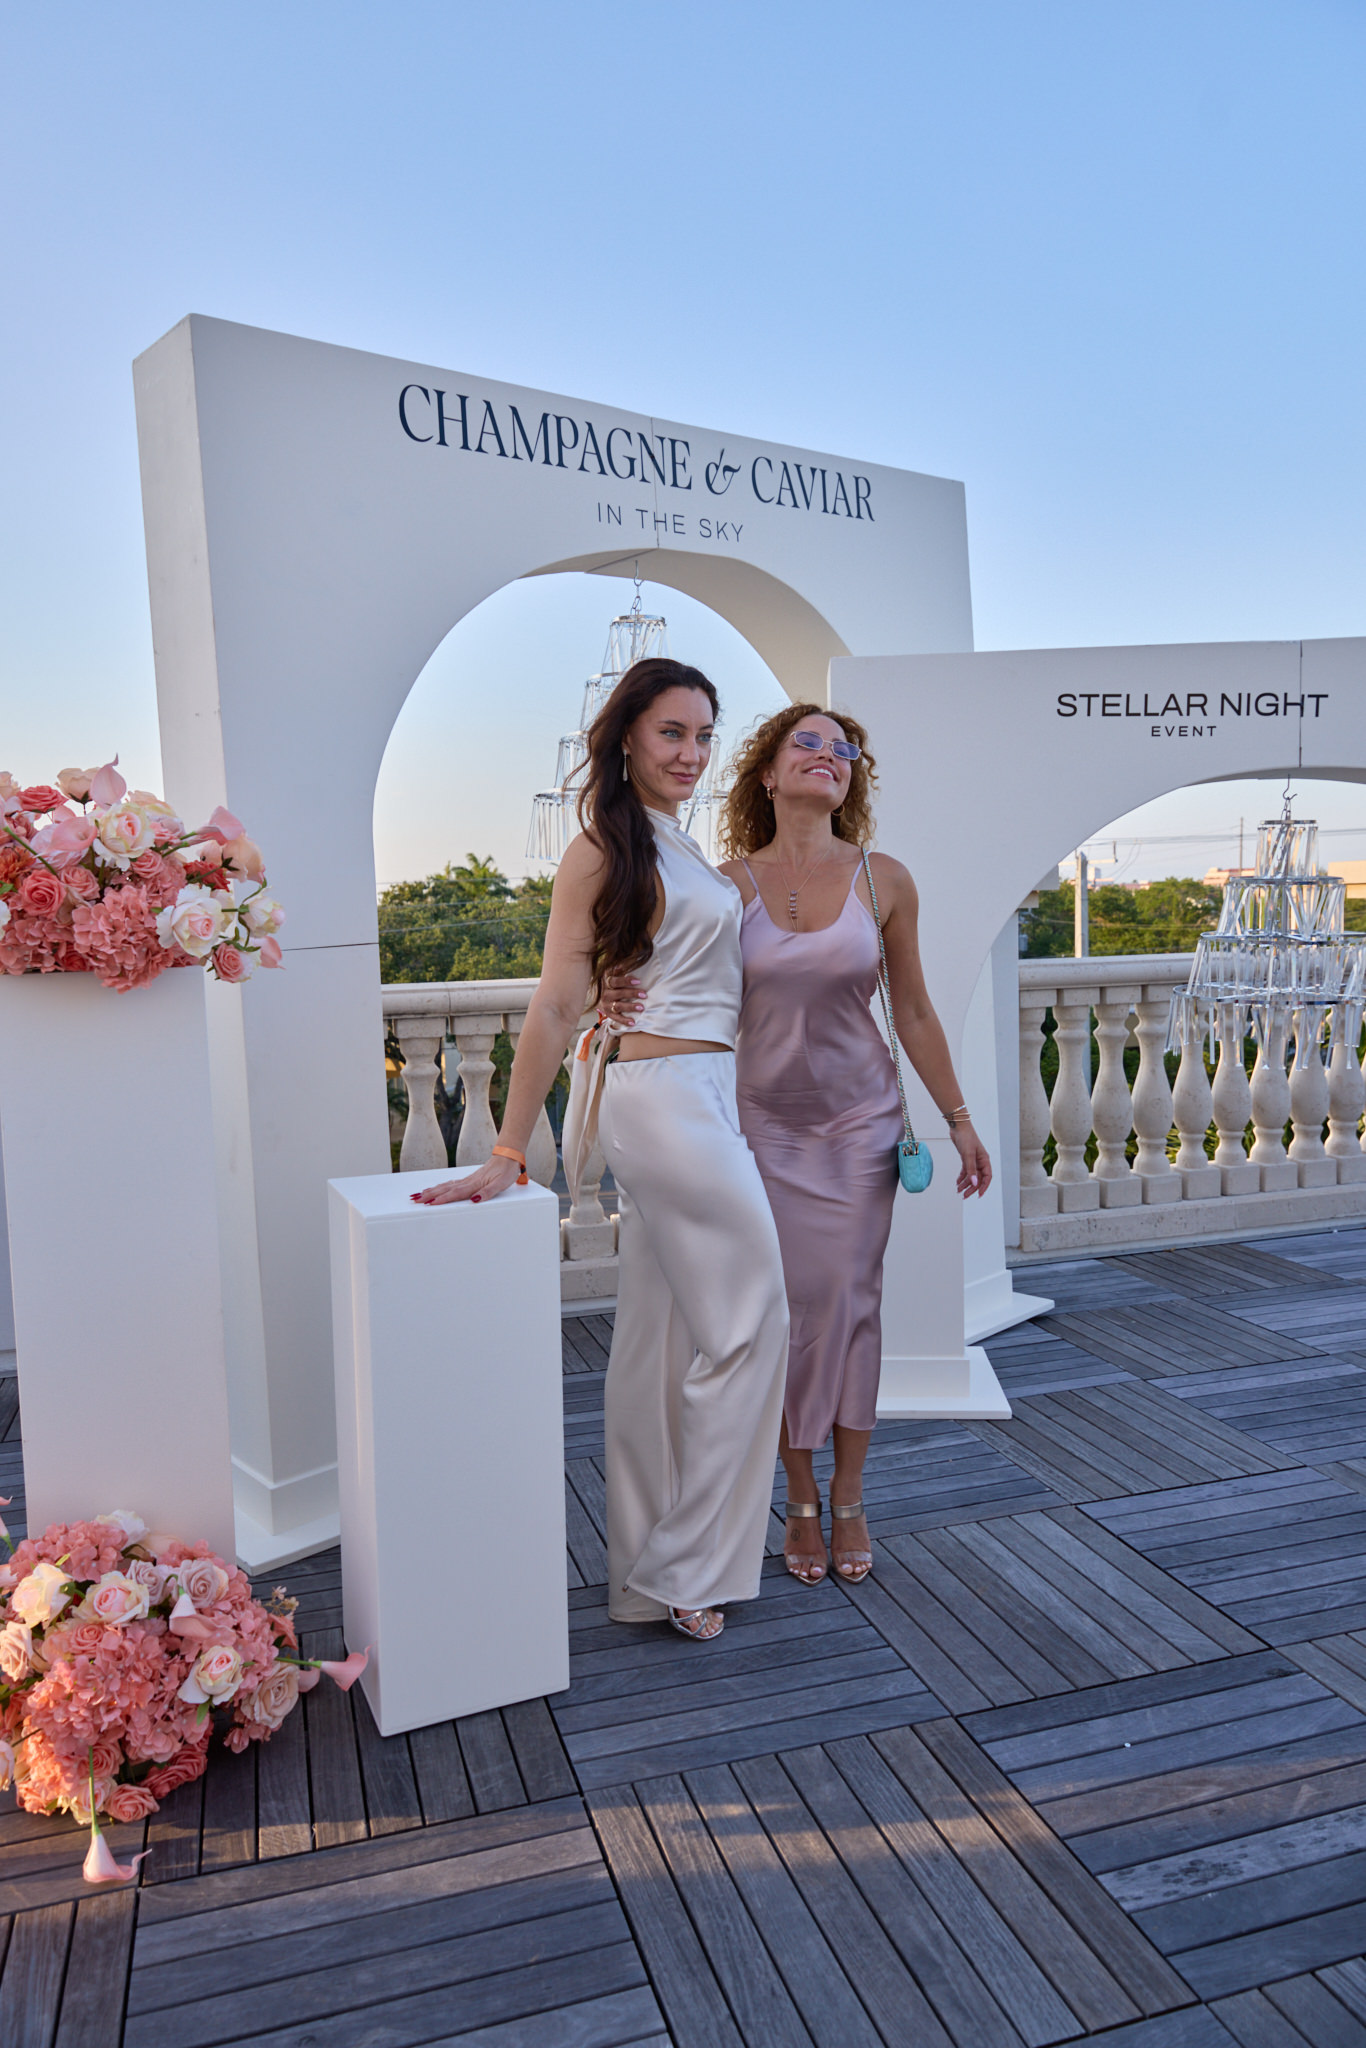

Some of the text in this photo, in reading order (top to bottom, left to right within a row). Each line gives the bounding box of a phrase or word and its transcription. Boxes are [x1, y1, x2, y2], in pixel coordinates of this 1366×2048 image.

[398, 384, 875, 522] CHAMPAGNE & CAVIAR
[597, 501, 744, 543] IN THE SKY
[1056, 692, 1329, 718] STELLAR NIGHT
[1150, 725, 1217, 737] EVENT
